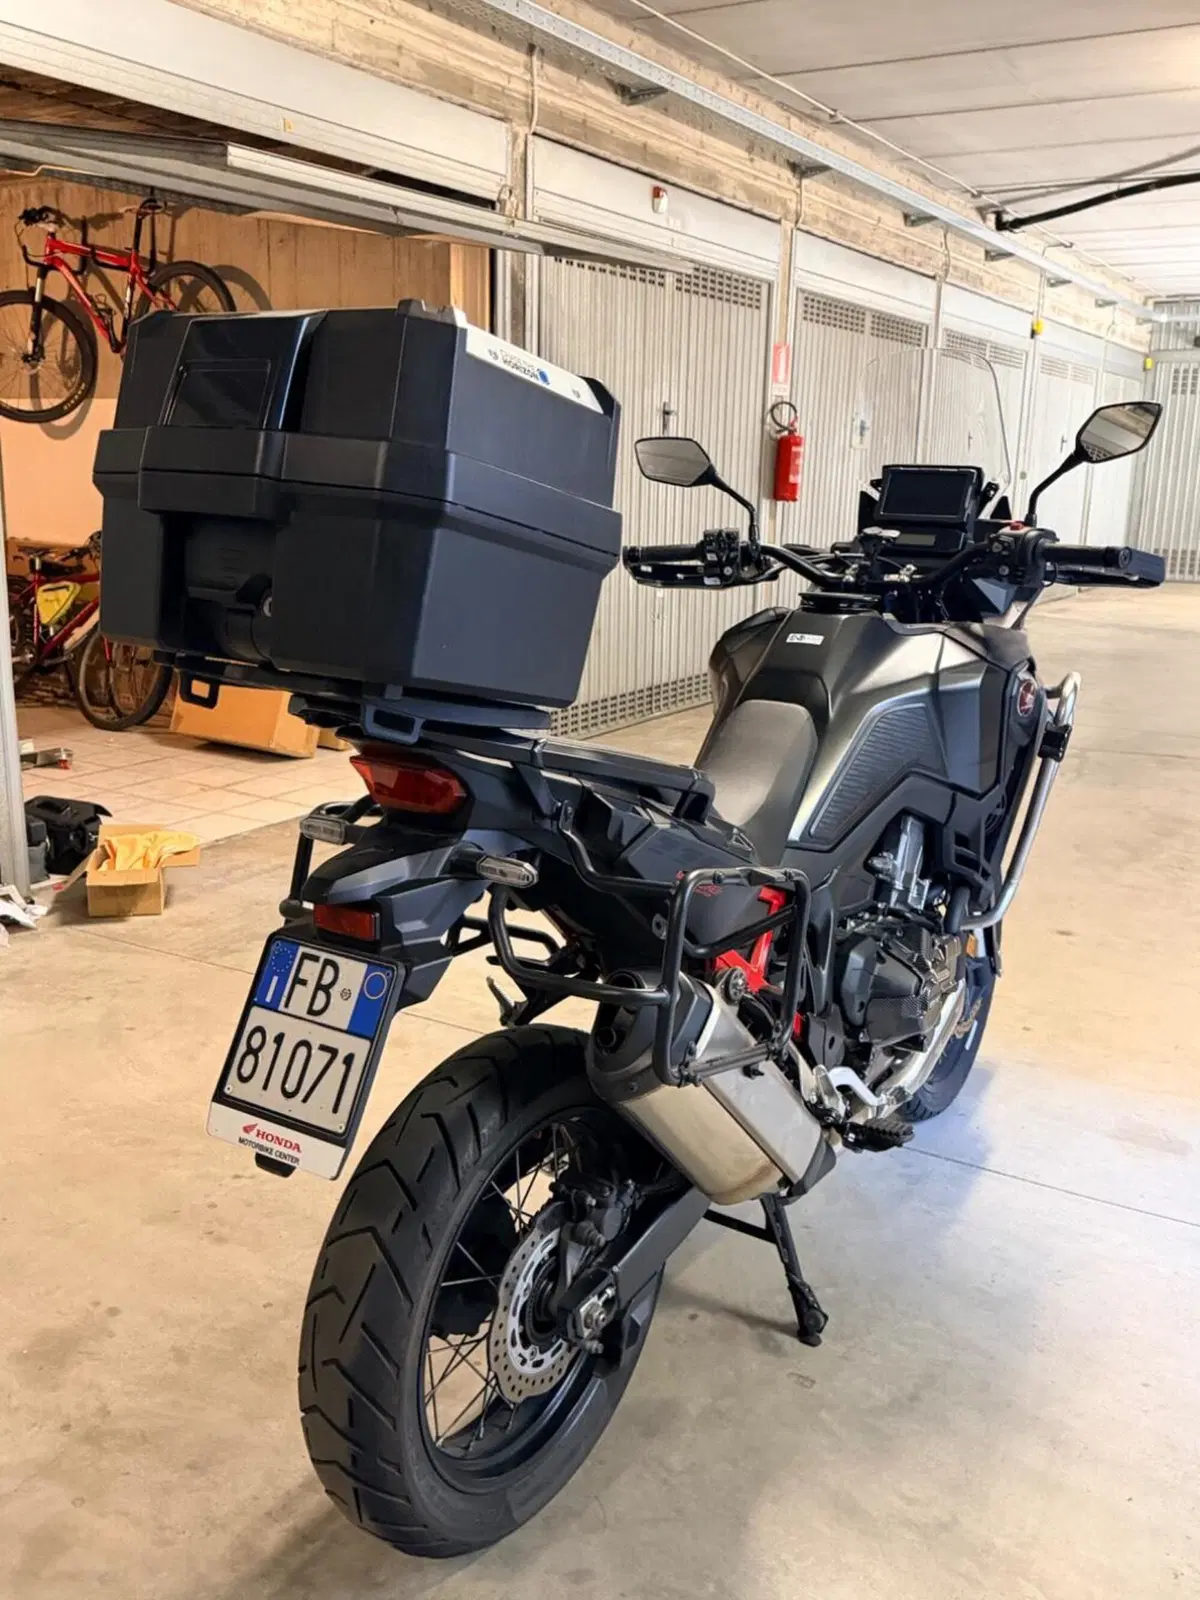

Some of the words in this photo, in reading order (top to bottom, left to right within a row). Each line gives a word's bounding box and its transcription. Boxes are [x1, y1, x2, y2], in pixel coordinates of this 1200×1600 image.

[284, 951, 340, 1017] FB
[236, 1025, 355, 1114] 81071
[238, 1136, 274, 1156] MOTORBIKE
[274, 1150, 300, 1166] CENTER
[255, 1128, 302, 1154] HONDA
